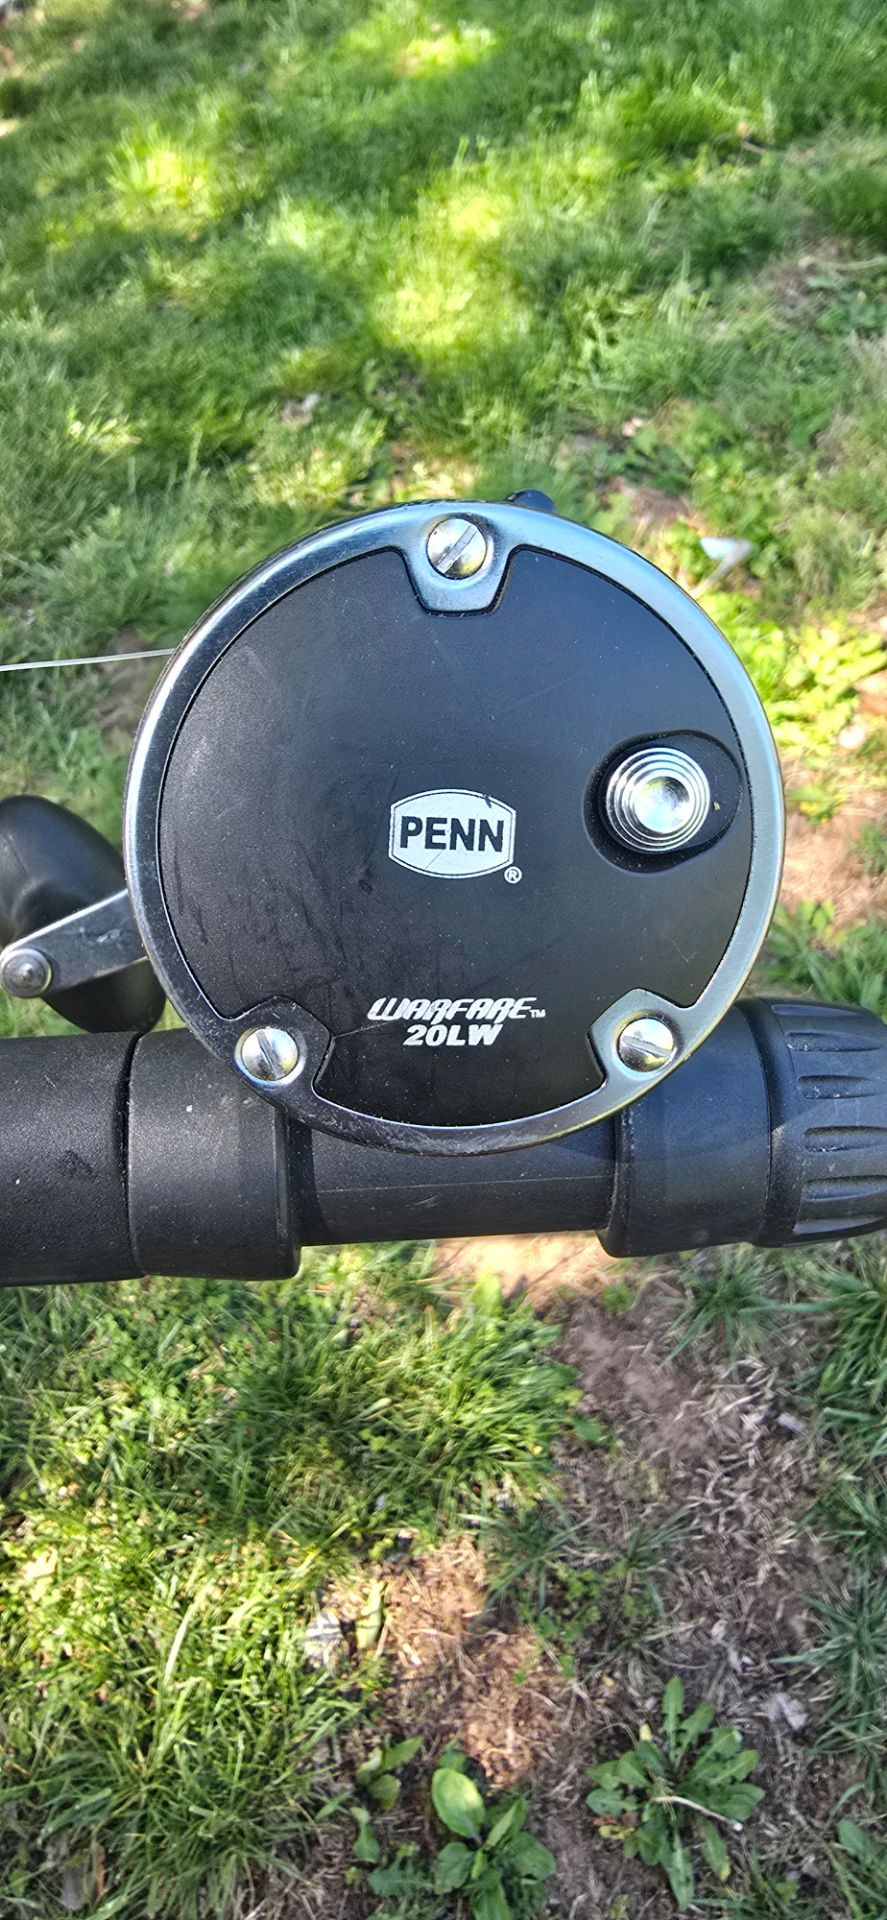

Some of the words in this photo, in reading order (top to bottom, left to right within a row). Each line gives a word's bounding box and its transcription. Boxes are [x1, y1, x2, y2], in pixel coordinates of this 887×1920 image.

[399, 815, 505, 852] PENN
[366, 997, 537, 1024] WARFARE
[402, 1023, 504, 1046] 20LW
